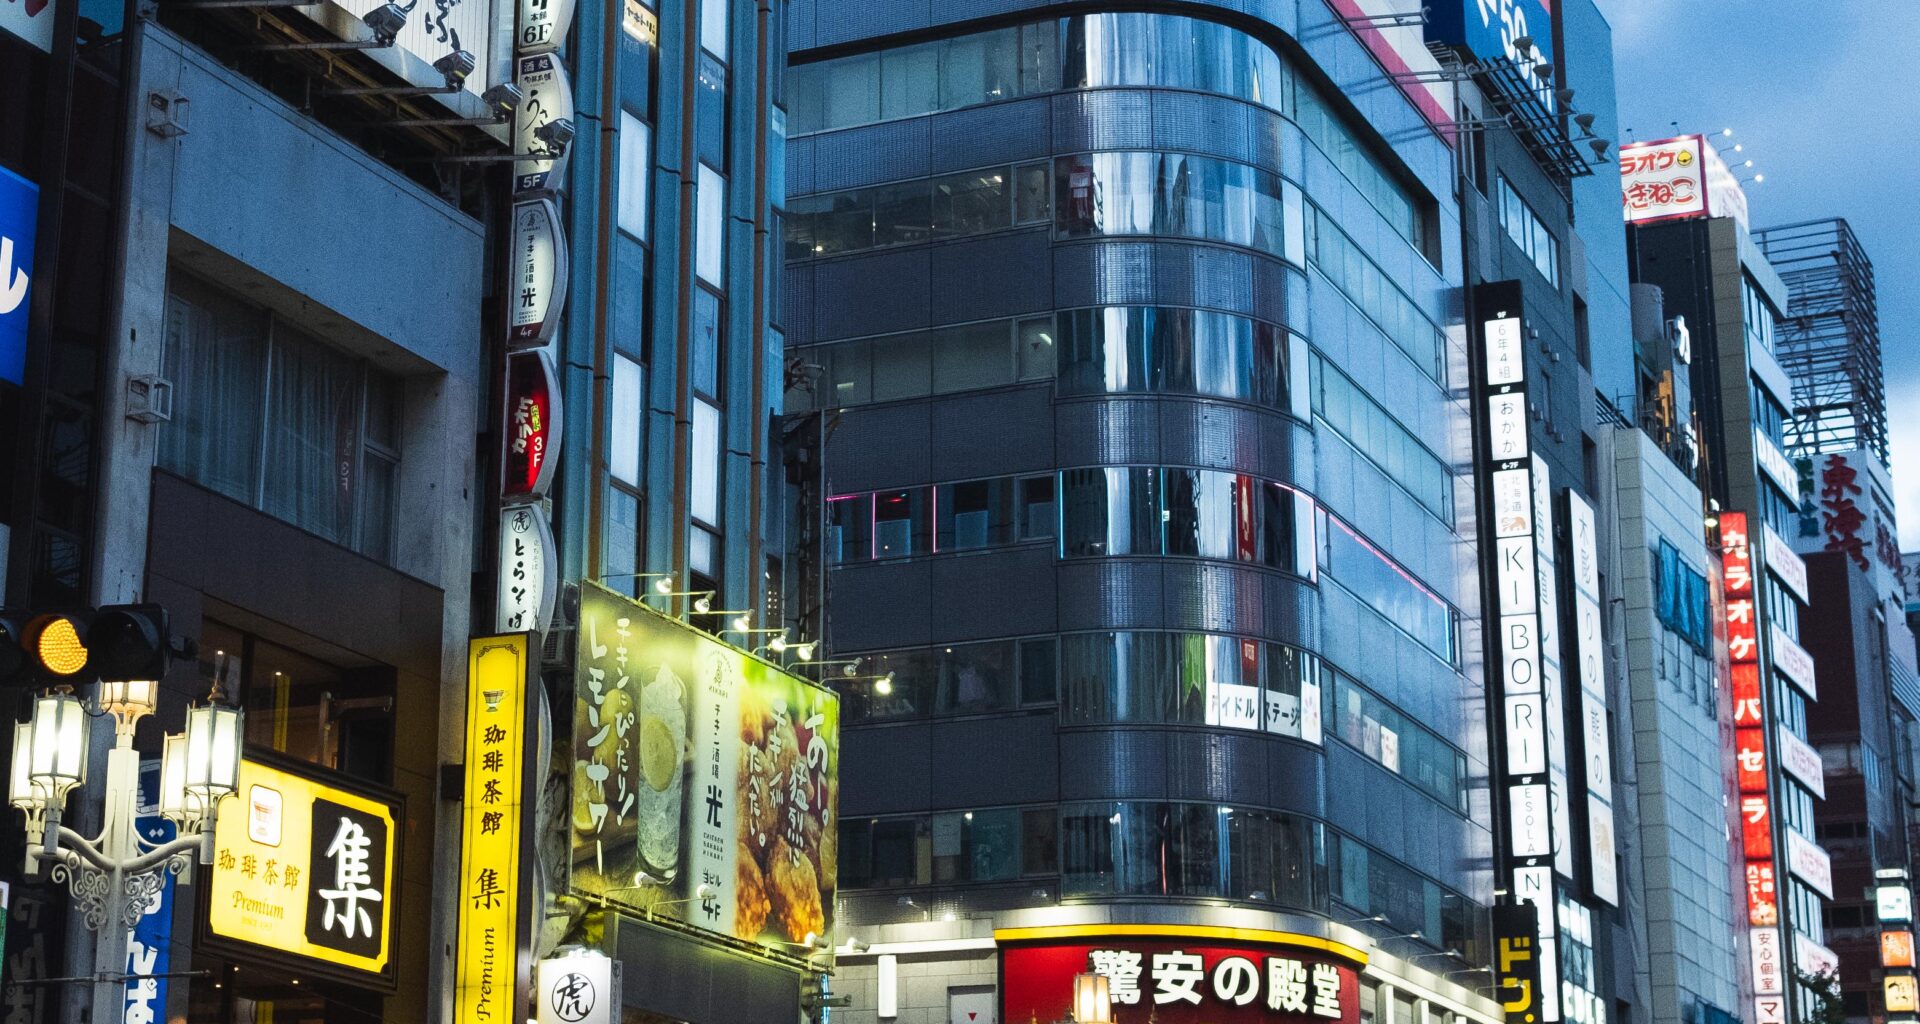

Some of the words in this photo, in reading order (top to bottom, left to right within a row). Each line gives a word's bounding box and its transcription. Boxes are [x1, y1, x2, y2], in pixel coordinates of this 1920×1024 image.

[524, 23, 551, 44] 6F
[523, 174, 541, 188] 5F
[1623, 178, 1694, 208] きねこ
[525, 234, 535, 284] チキン酒場
[520, 287, 537, 308] 光
[520, 326, 532, 337] 4F
[1498, 324, 1511, 379] 6年4組
[512, 396, 534, 454] カラオケ
[1500, 402, 1517, 453] おかか
[1502, 461, 1519, 470] 6-7F
[508, 538, 527, 629] とらそば
[1722, 530, 1756, 660] カラオケ
[1505, 545, 1533, 764] KIBORI
[586, 615, 610, 876] レモンサワー
[615, 617, 635, 827] チキンにぴったり！
[712, 703, 721, 780] チキン酒場
[481, 723, 506, 836] 珈琲茶館
[1734, 698, 1767, 824] パセラ
[706, 784, 723, 829] 光
[1524, 788, 1536, 853] ESOLA
[218, 848, 301, 892] 珈琲茶館
[316, 816, 382, 939] 集
[472, 867, 505, 910] 集
[232, 889, 284, 921] Premium
[702, 897, 721, 922] 4F
[477, 926, 495, 1022] Premium
[1089, 950, 1342, 1019] 驚安の殿堂
[1758, 933, 1775, 991] 安心個室
[556, 972, 590, 1017] 虎
